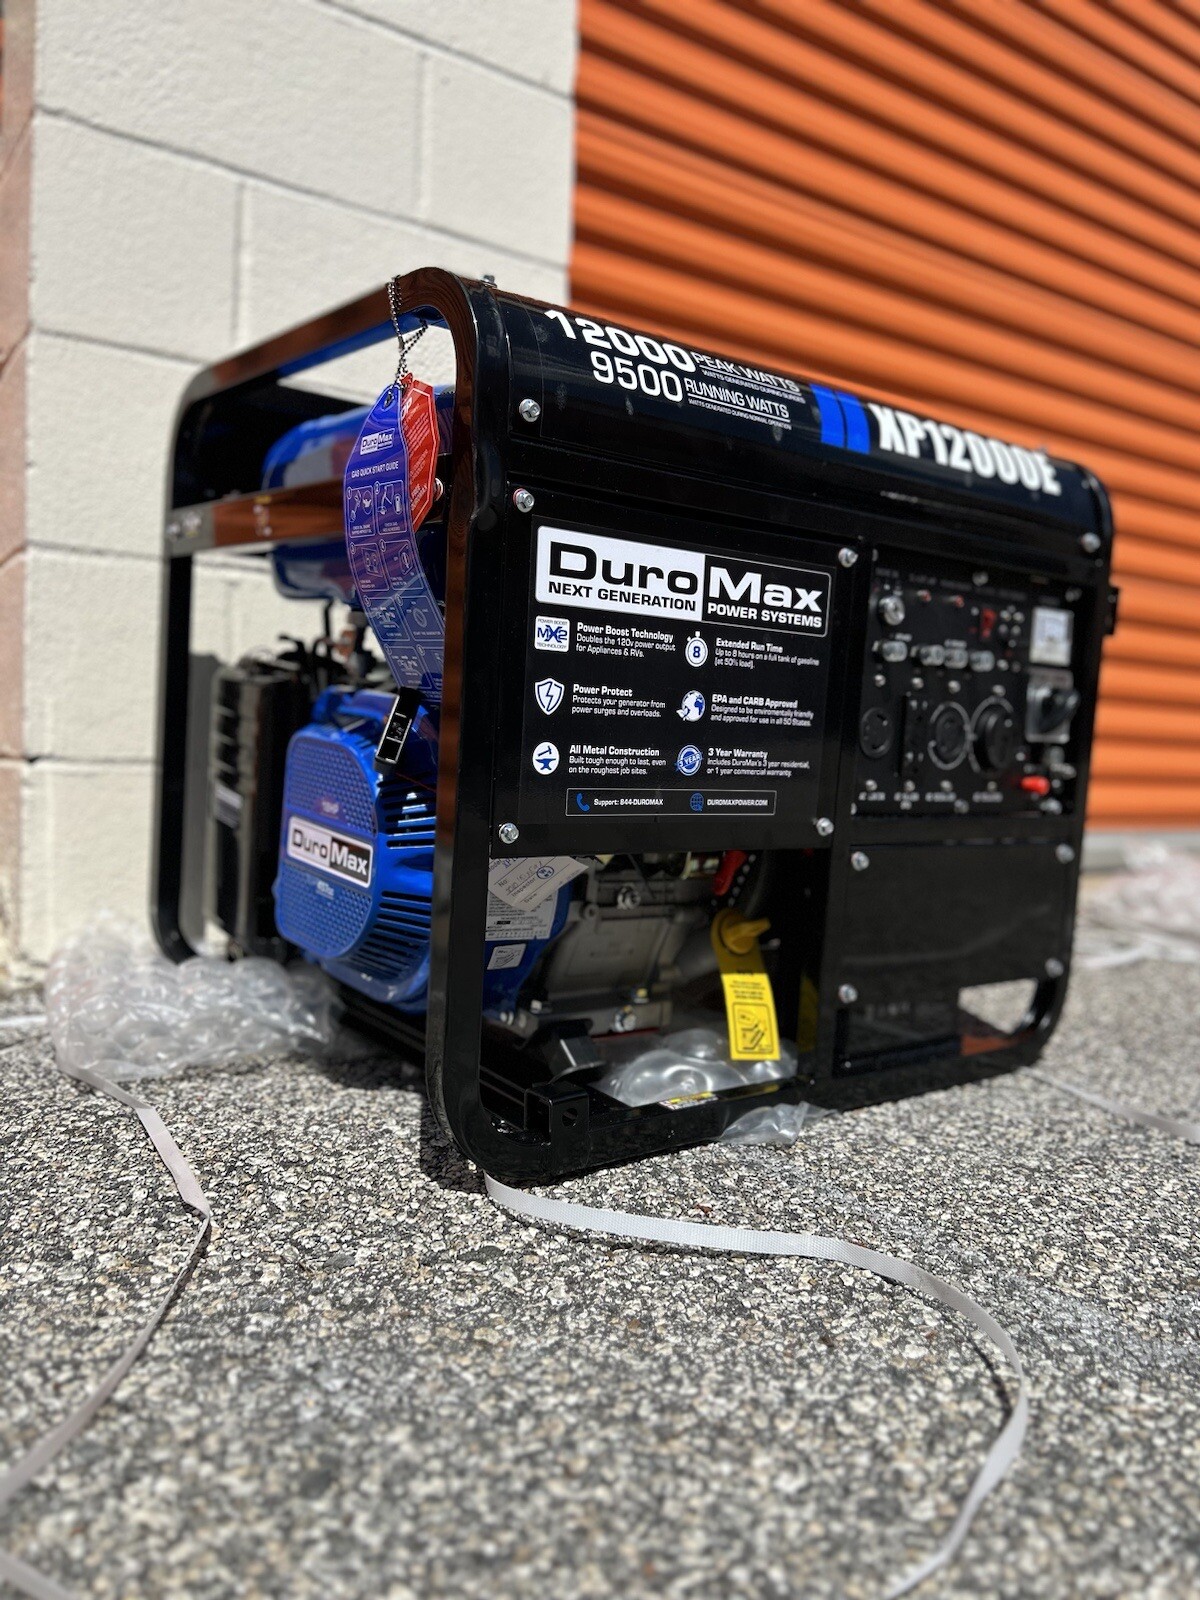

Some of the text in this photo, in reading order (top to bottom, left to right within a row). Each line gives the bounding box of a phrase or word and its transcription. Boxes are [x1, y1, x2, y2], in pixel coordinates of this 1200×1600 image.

[544, 309, 696, 372] 12000
[590, 351, 683, 402] 9500
[690, 351, 800, 392] PEAK WATTS
[683, 377, 790, 418] RUNNING WATTS
[867, 402, 1062, 496] XP12000E
[351, 461, 399, 478] GAS QUICK START GUIDE
[549, 541, 823, 613] DuroMax
[548, 581, 697, 612] NEXT GENERATION
[707, 602, 822, 628] POWER SYSTEMS
[577, 622, 674, 643] Power Boost Technology
[537, 642, 567, 650] TECHNOLOGY
[577, 633, 676, 652] Doubles the 120v power output
[716, 638, 783, 653] Extended Run Time
[576, 644, 645, 657] for Appliances & RVs.
[692, 646, 701, 658] 8
[715, 648, 724, 657] Up
[725, 649, 732, 657] to
[732, 649, 737, 658] 8
[738, 650, 754, 659] hours
[768, 653, 777, 662] full
[778, 655, 790, 663] tank
[790, 656, 797, 664] of
[797, 657, 820, 666] gasoline
[724, 658, 738, 667] 50%
[573, 684, 633, 697] Power Protect
[572, 695, 666, 709] Protects your generator from
[712, 693, 798, 709] EPA and CARB Approved
[571, 706, 662, 718] power surges and overloads.
[711, 704, 738, 714] Designed
[738, 706, 745, 714] to
[746, 706, 753, 714] be
[794, 709, 814, 720] friendly
[722, 714, 749, 723] approved
[749, 716, 758, 724] for
[770, 716, 775, 724] in
[775, 717, 783, 725] all
[783, 717, 791, 725] 50
[569, 744, 660, 757] All Metal Construction
[708, 747, 768, 760] 3 Year Warranty
[569, 756, 584, 764] Built
[585, 757, 604, 766] tough
[605, 757, 628, 767] enough
[629, 758, 636, 766] to
[637, 758, 651, 766] last,
[684, 753, 701, 766] YEAR
[707, 758, 731, 766] Includes
[731, 758, 762, 767] DuroMax's
[762, 759, 767, 767] 3
[767, 761, 780, 769] year
[578, 766, 590, 774] the
[590, 766, 620, 776] roughest
[620, 767, 630, 776] job
[631, 767, 648, 775] sites.
[719, 768, 733, 776] year
[593, 798, 664, 807] Support: 844-DUROMAX
[707, 798, 769, 806] DUROMAXPOWER.COM
[291, 828, 368, 876] DuroMax
[511, 878, 536, 897] Inspector
